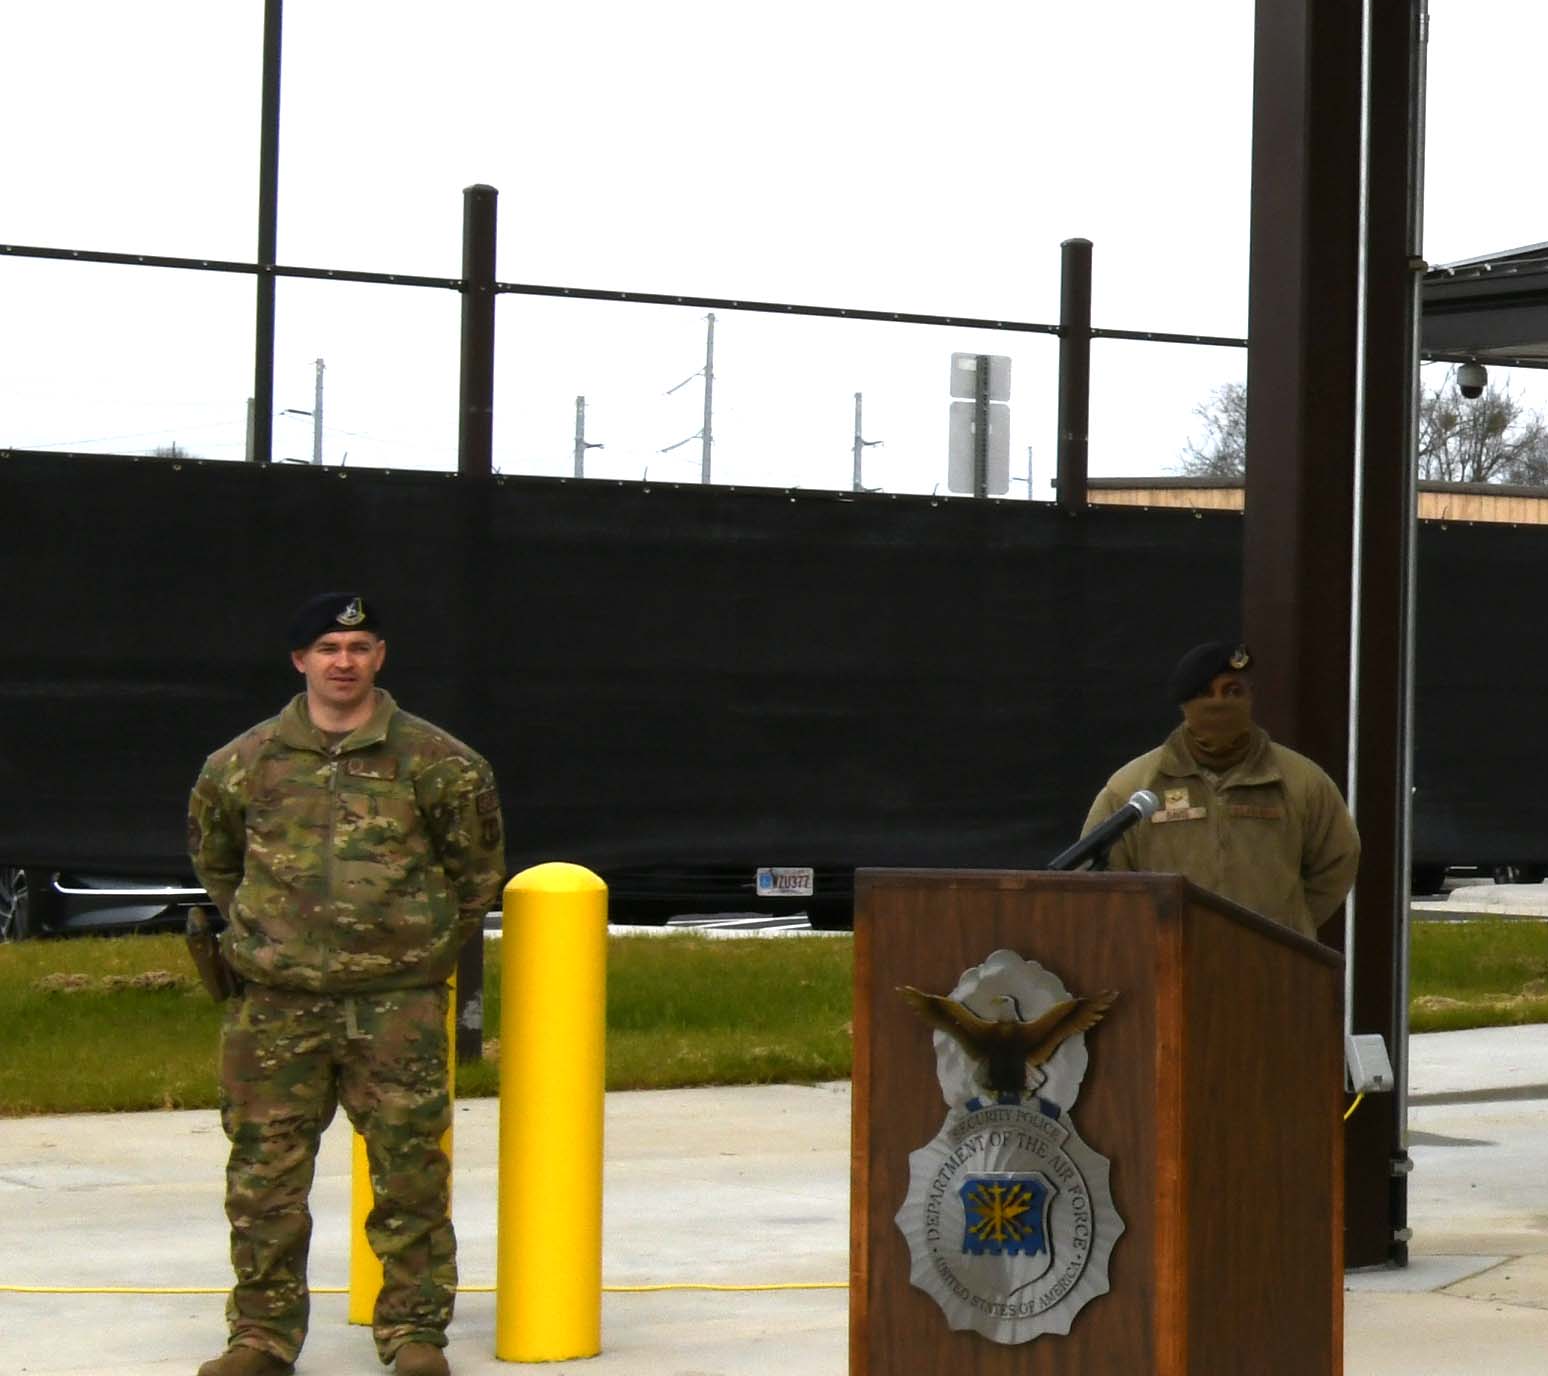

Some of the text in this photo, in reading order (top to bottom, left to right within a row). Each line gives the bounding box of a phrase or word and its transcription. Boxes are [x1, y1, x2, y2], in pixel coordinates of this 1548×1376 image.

[954, 1108, 1059, 1140] SECURITY POLICE
[928, 1131, 1089, 1250] DEPARTMENT OF THE AIR FORCE
[935, 1256, 1083, 1316] UNITED STATES OF AMERICA
